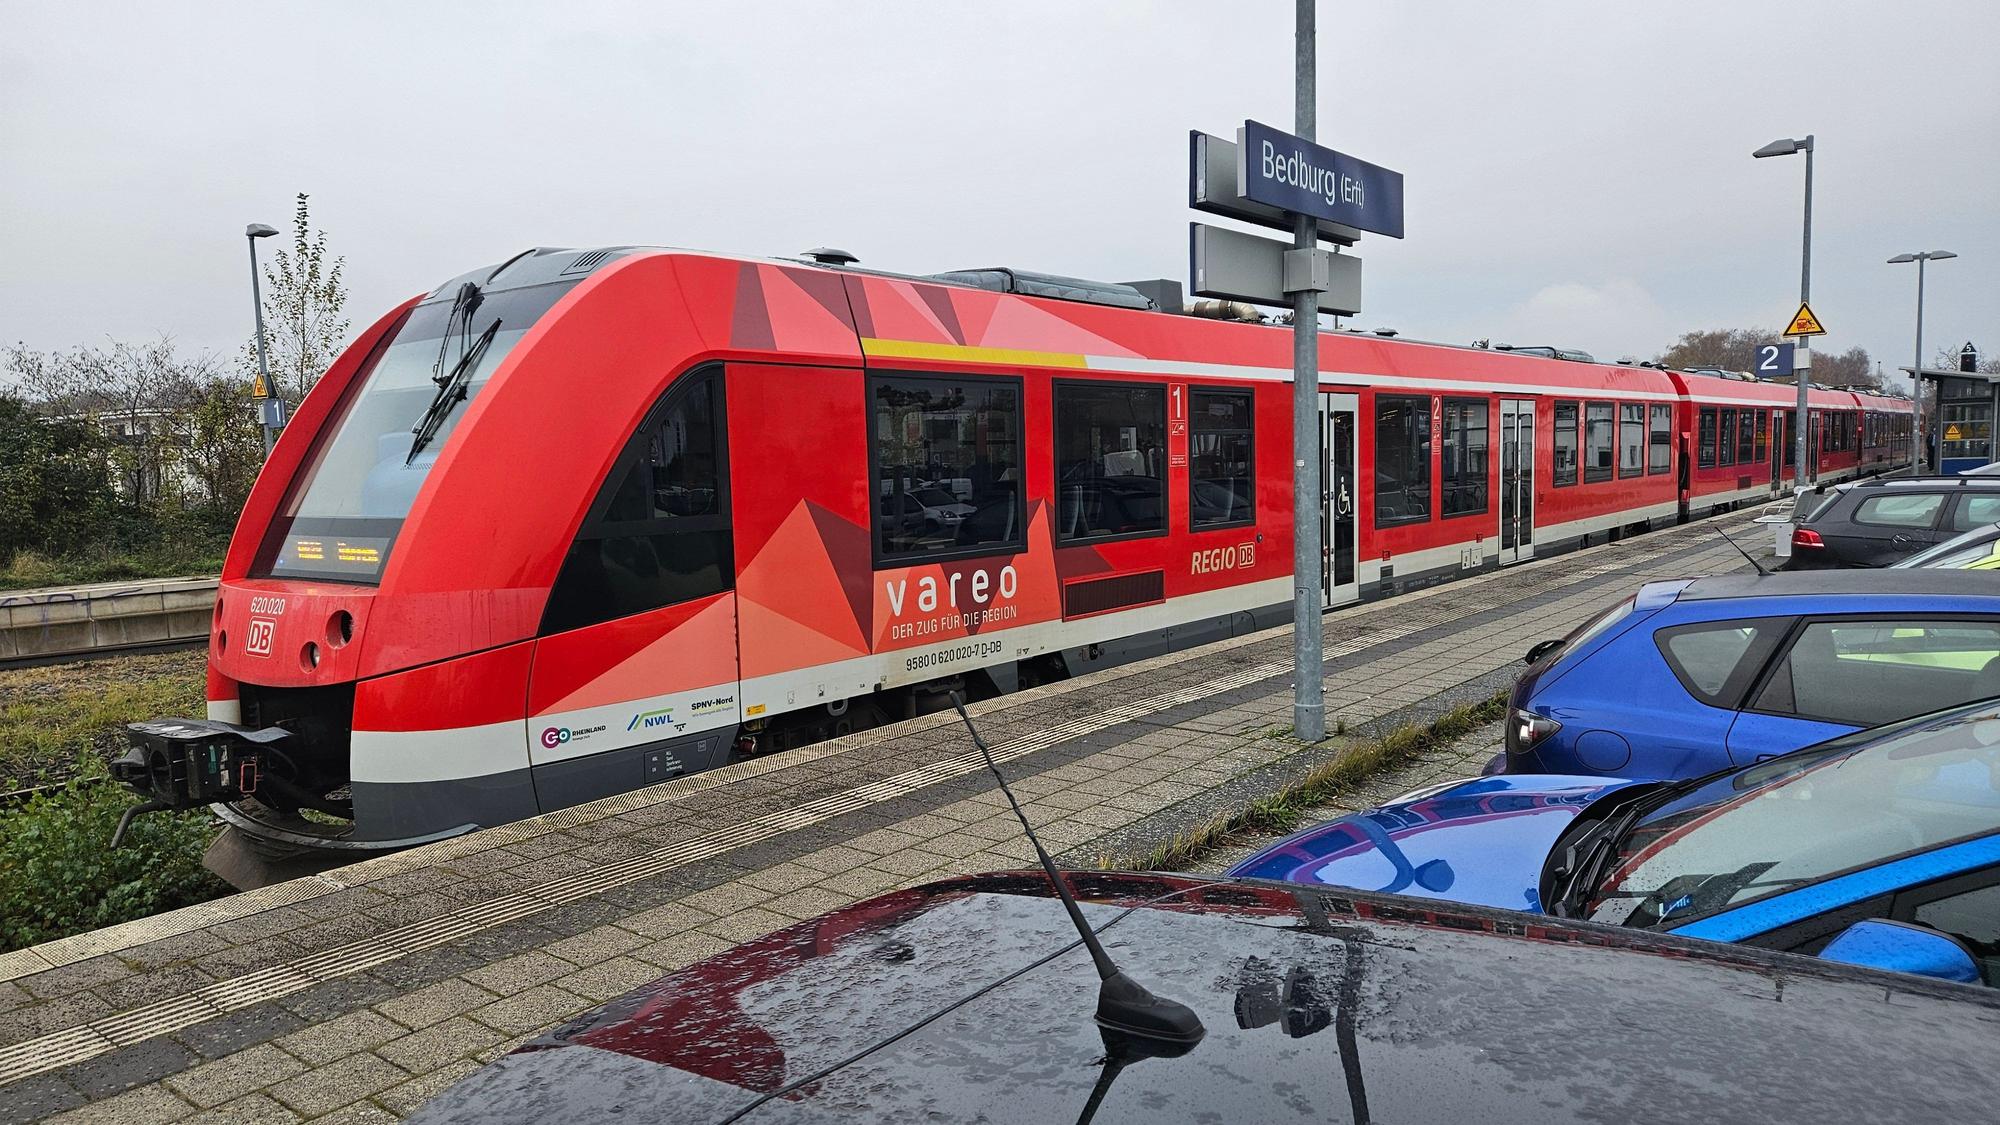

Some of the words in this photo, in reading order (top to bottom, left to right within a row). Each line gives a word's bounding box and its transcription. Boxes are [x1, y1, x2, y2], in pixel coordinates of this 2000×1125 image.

[1262, 139, 1335, 206] Bedburg
[1340, 173, 1365, 209] (Erft)
[1760, 345, 1779, 371] 2
[1966, 344, 1972, 353] 5
[273, 401, 280, 422] 1
[1172, 386, 1181, 419] 1
[1433, 396, 1440, 420] 2
[1191, 546, 1236, 575] REGIO
[1240, 545, 1254, 564] DB
[886, 565, 1017, 617] vareo
[251, 596, 267, 613] 620
[267, 598, 286, 615] 020
[892, 624, 914, 640] DER
[916, 618, 938, 634] ZUG
[941, 613, 960, 630] FÜR
[963, 611, 980, 627] DIE
[982, 605, 1017, 623] REGION
[249, 622, 272, 652] DB
[981, 640, 1002, 658] D-DB
[691, 695, 734, 711] SPNV-Nord
[572, 725, 607, 736] RHEINLAND
[644, 714, 674, 728] NWL
